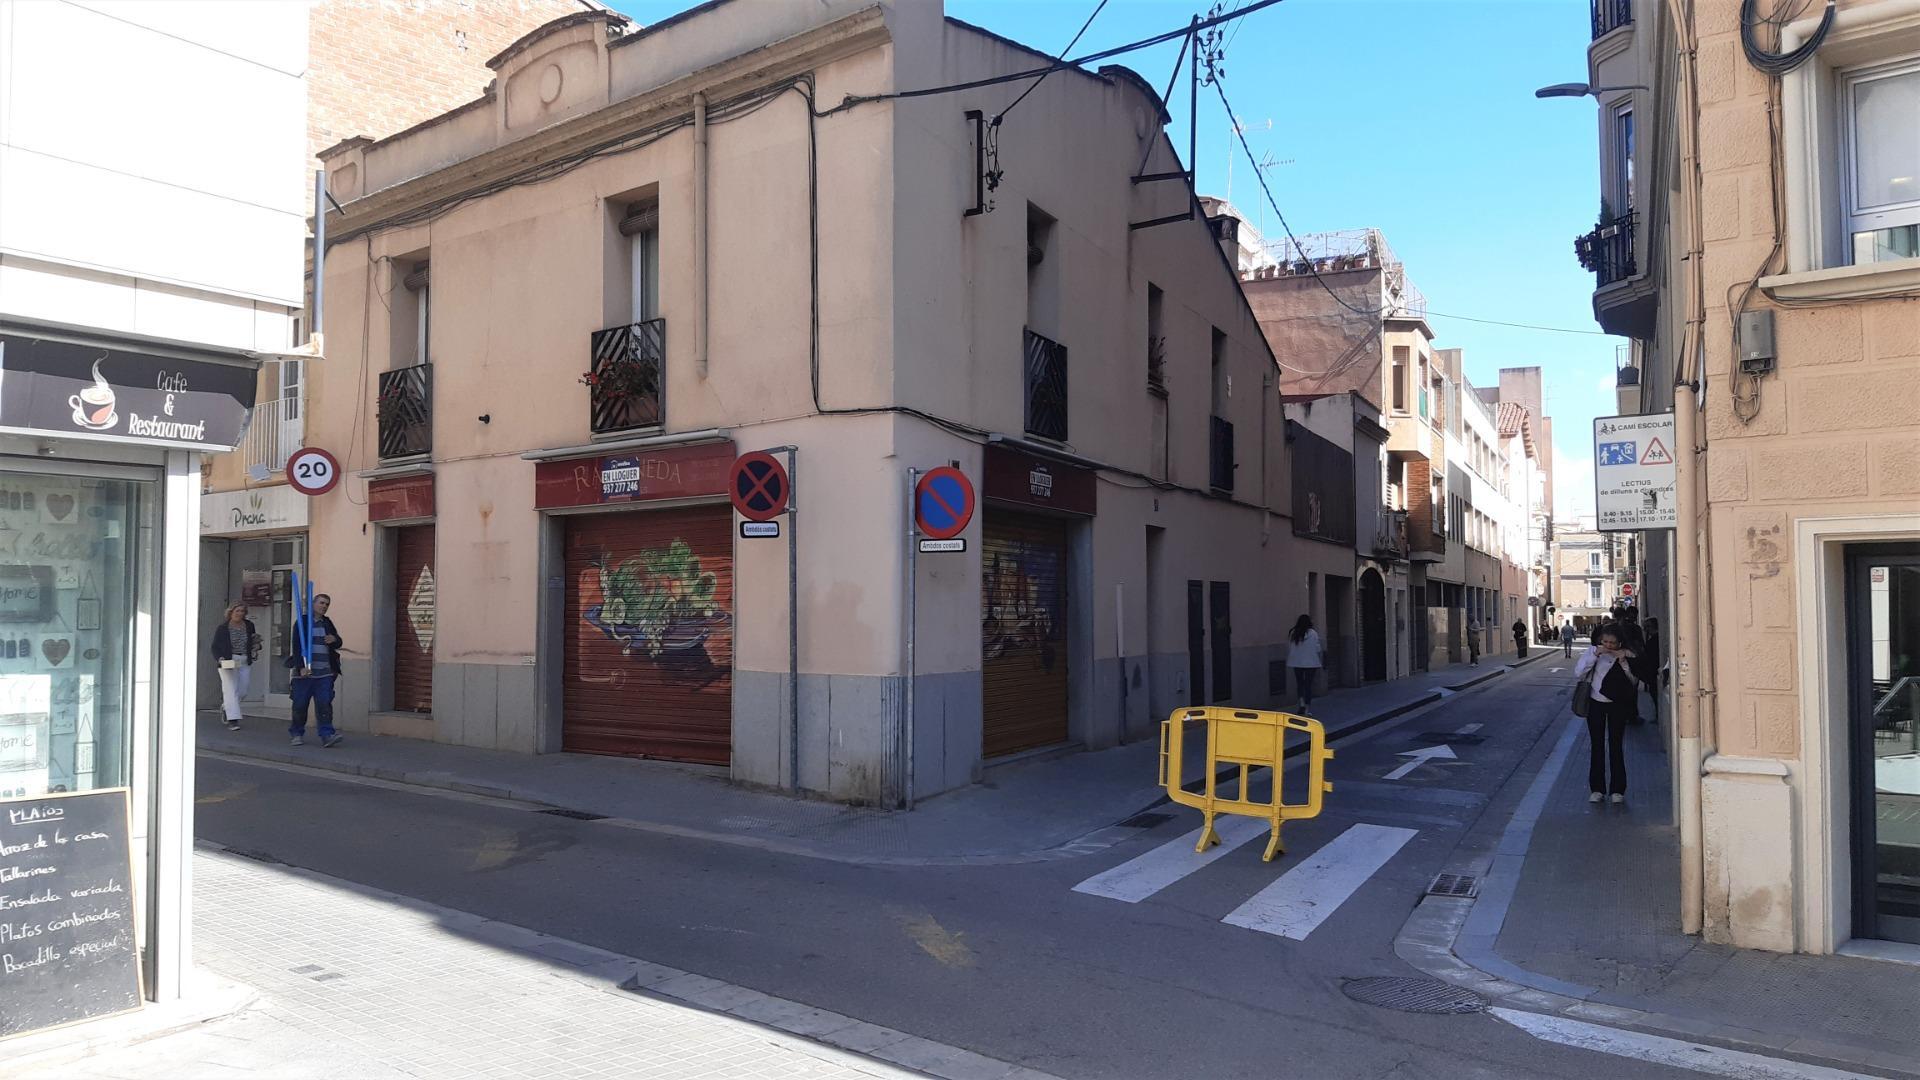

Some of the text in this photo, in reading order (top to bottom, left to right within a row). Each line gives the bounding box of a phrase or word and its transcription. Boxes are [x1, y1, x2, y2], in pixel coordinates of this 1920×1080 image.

[157, 370, 188, 394] Cafe
[163, 394, 174, 416] &
[128, 412, 205, 440] Restaurant
[1638, 421, 1672, 429] ESCOLAR
[298, 461, 327, 479] 20
[603, 469, 638, 482] EN LLOGUER
[603, 483, 614, 494] 937
[615, 482, 626, 493] 277
[626, 480, 639, 492] 246
[231, 507, 266, 528] Prana
[34, 834, 48, 849] de
[55, 828, 69, 844] la
[74, 831, 109, 841] casa
[0, 864, 57, 884] Tallarines
[0, 878, 123, 911] Ensalada variada
[0, 907, 121, 945] Platos combinados
[2, 935, 118, 975] Bocadillo especial
